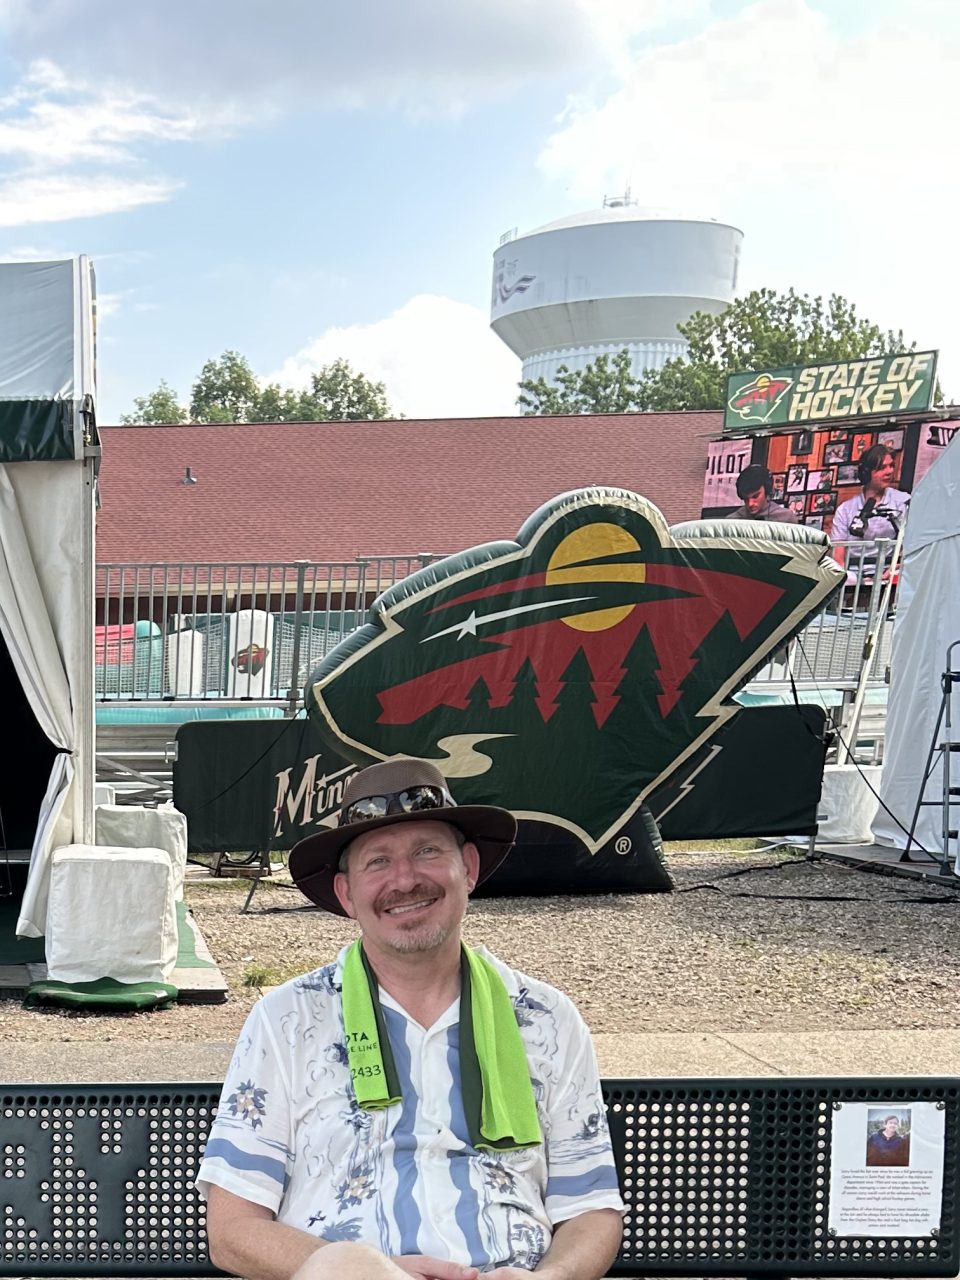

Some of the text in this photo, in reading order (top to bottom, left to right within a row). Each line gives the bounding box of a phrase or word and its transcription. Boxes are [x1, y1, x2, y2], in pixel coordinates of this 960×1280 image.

[796, 354, 932, 392] STATE OF
[789, 379, 923, 421] HOCKEY
